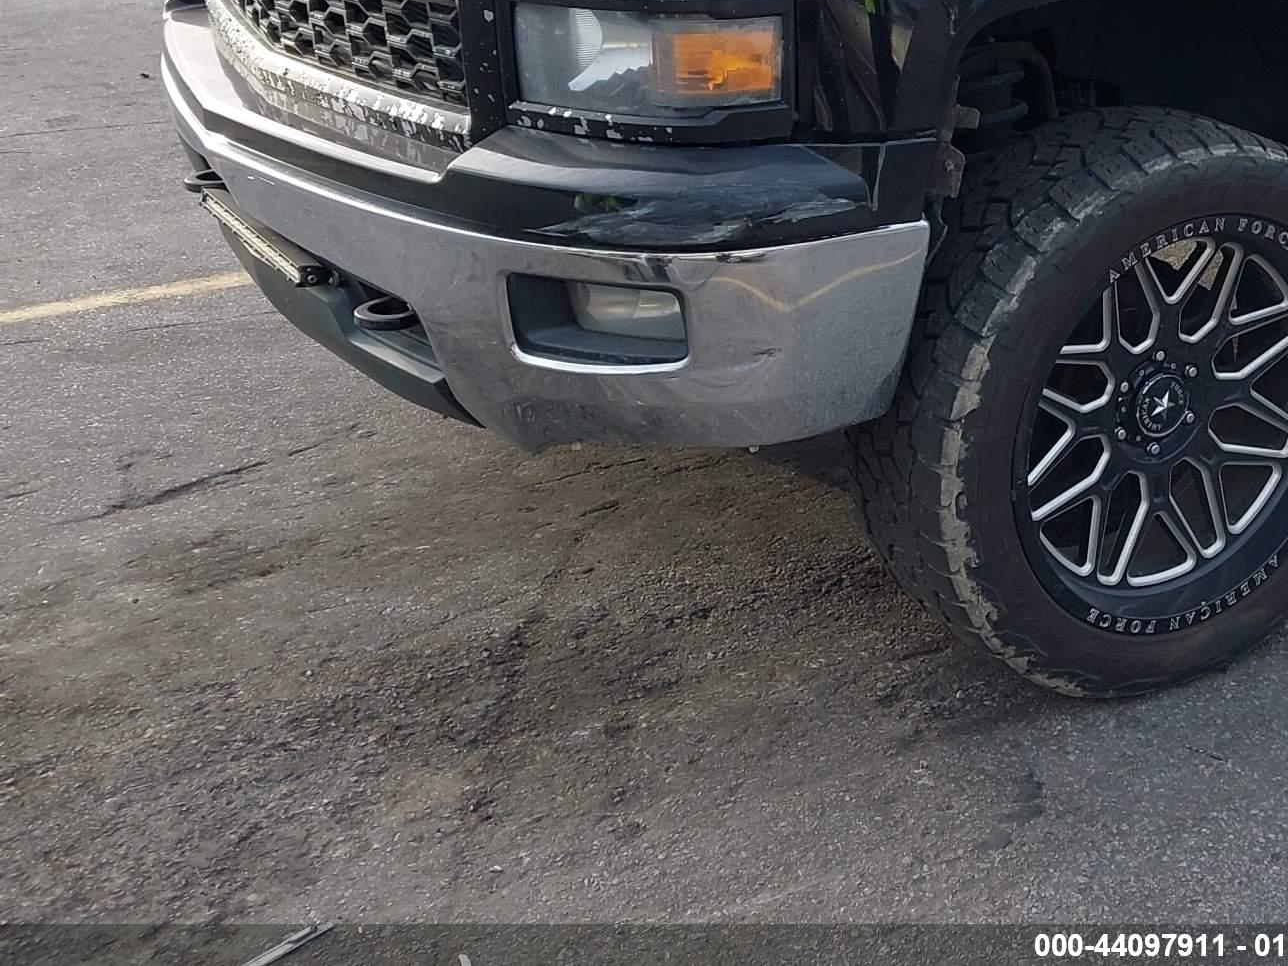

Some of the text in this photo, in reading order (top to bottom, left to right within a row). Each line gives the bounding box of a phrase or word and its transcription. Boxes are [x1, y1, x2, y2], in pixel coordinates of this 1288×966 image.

[1109, 217, 1226, 283] AMERICAN
[1141, 397, 1163, 431] AMERICAN
[1086, 554, 1280, 634] AMERICAN FORCE
